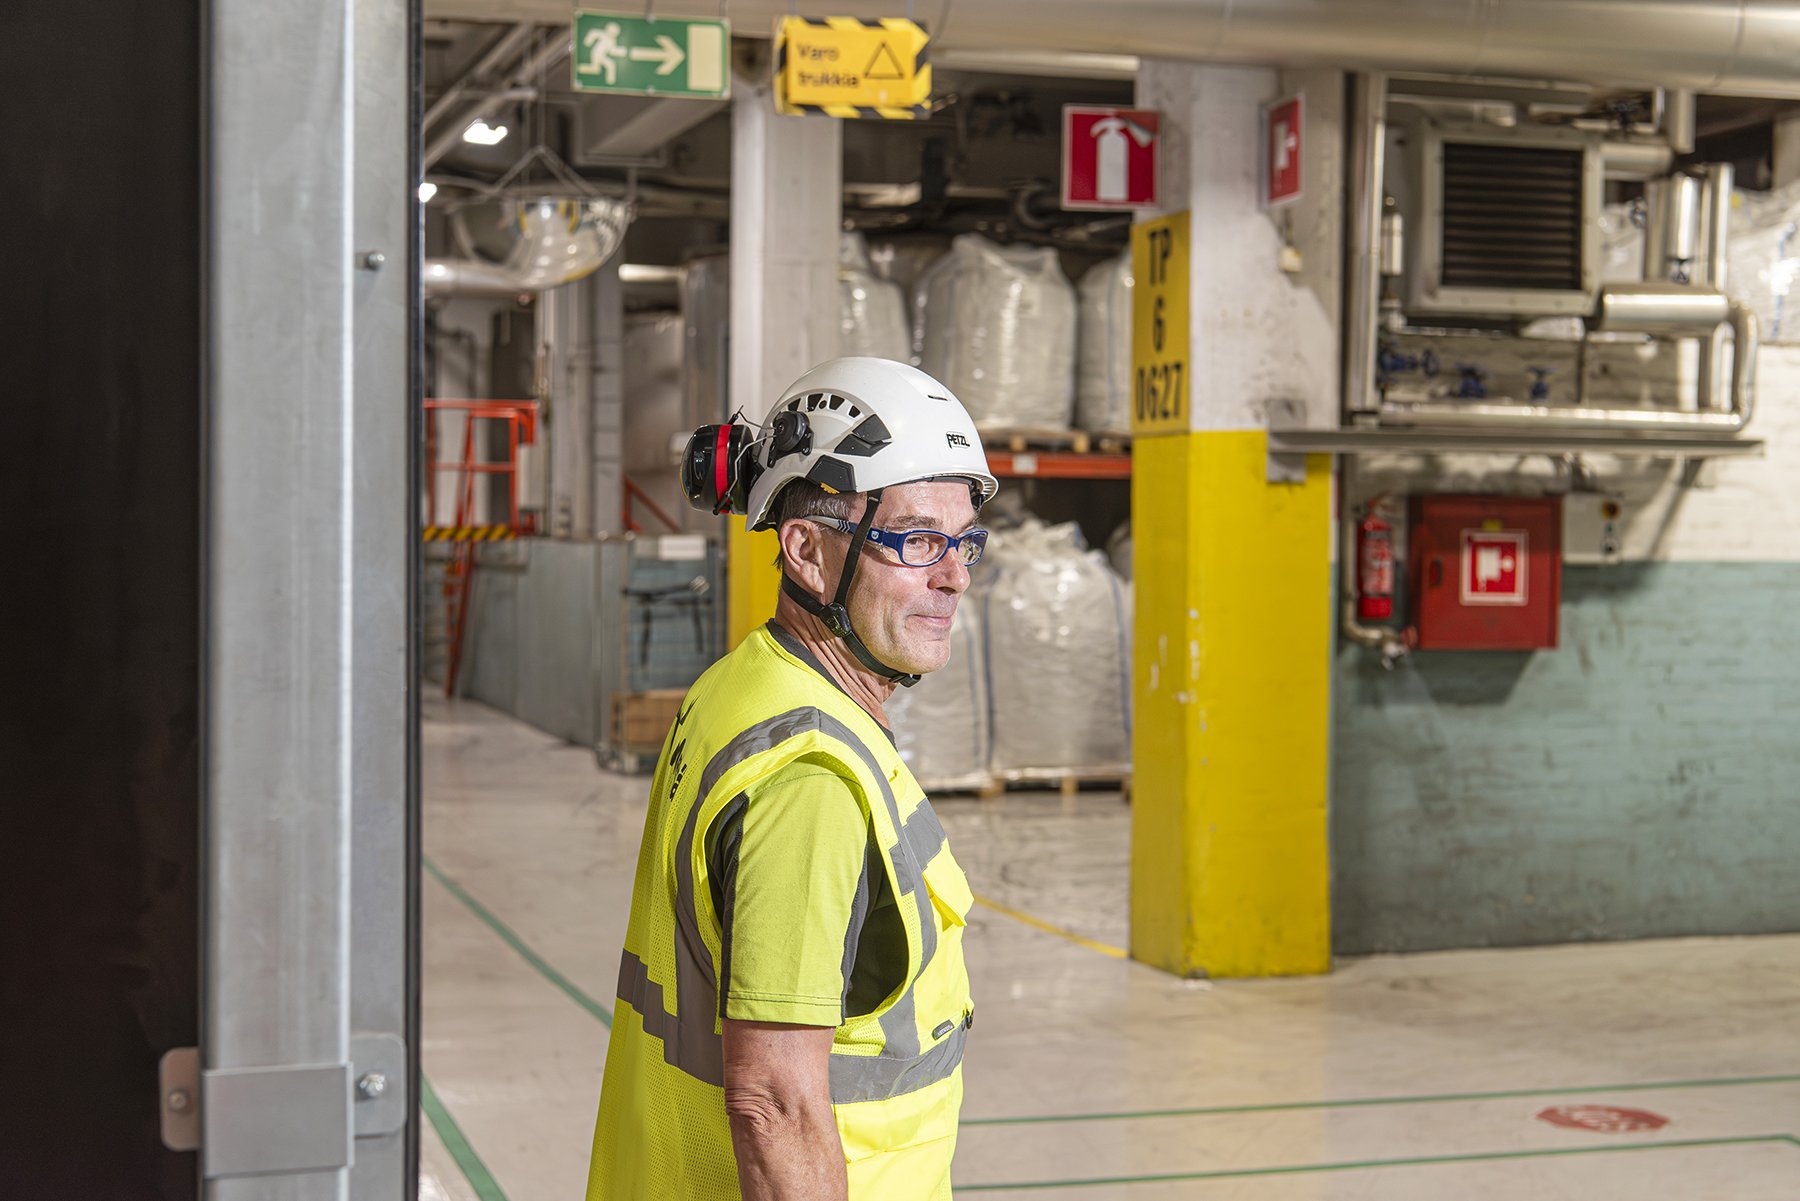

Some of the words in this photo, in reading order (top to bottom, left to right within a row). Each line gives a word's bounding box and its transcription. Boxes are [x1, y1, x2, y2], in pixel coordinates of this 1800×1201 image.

[797, 43, 838, 60] Varo
[797, 70, 860, 87] trukkia
[1147, 226, 1172, 285] TP
[1152, 295, 1166, 352] 6
[1135, 362, 1183, 421] 0627
[946, 432, 970, 449] PETZL
